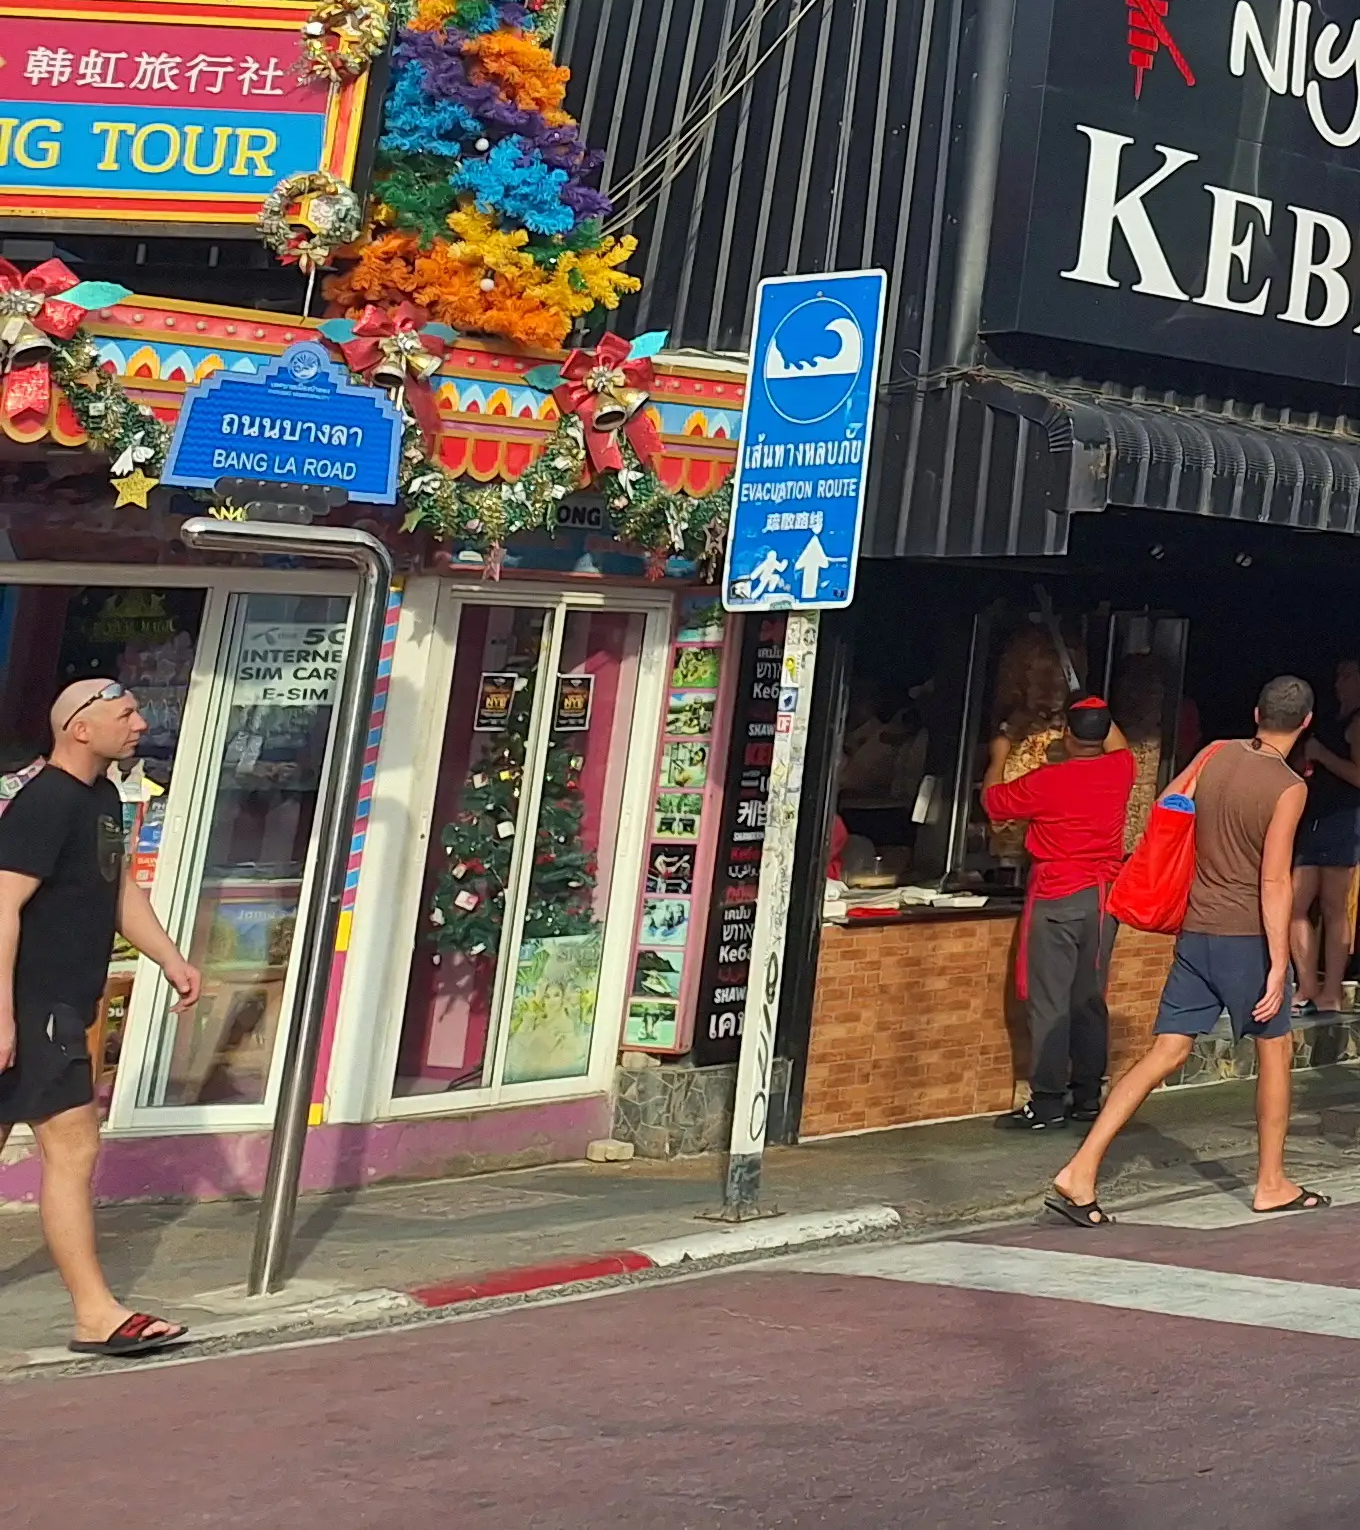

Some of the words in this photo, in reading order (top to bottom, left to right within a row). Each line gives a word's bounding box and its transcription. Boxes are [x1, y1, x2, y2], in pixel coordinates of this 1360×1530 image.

[24, 47, 285, 97] 韩虹旅行社
[93, 122, 279, 178] TOUR
[221, 413, 363, 448] ถนนบางลา
[745, 424, 864, 470] เส้นทางหลบภัย
[212, 448, 268, 472] BANG
[273, 455, 297, 475] LA
[303, 458, 357, 481] ROAD
[741, 479, 813, 503] EVACUATION
[817, 477, 858, 499] ROUTE
[240, 670, 283, 681] SIM
[262, 688, 329, 701] E-SIM
